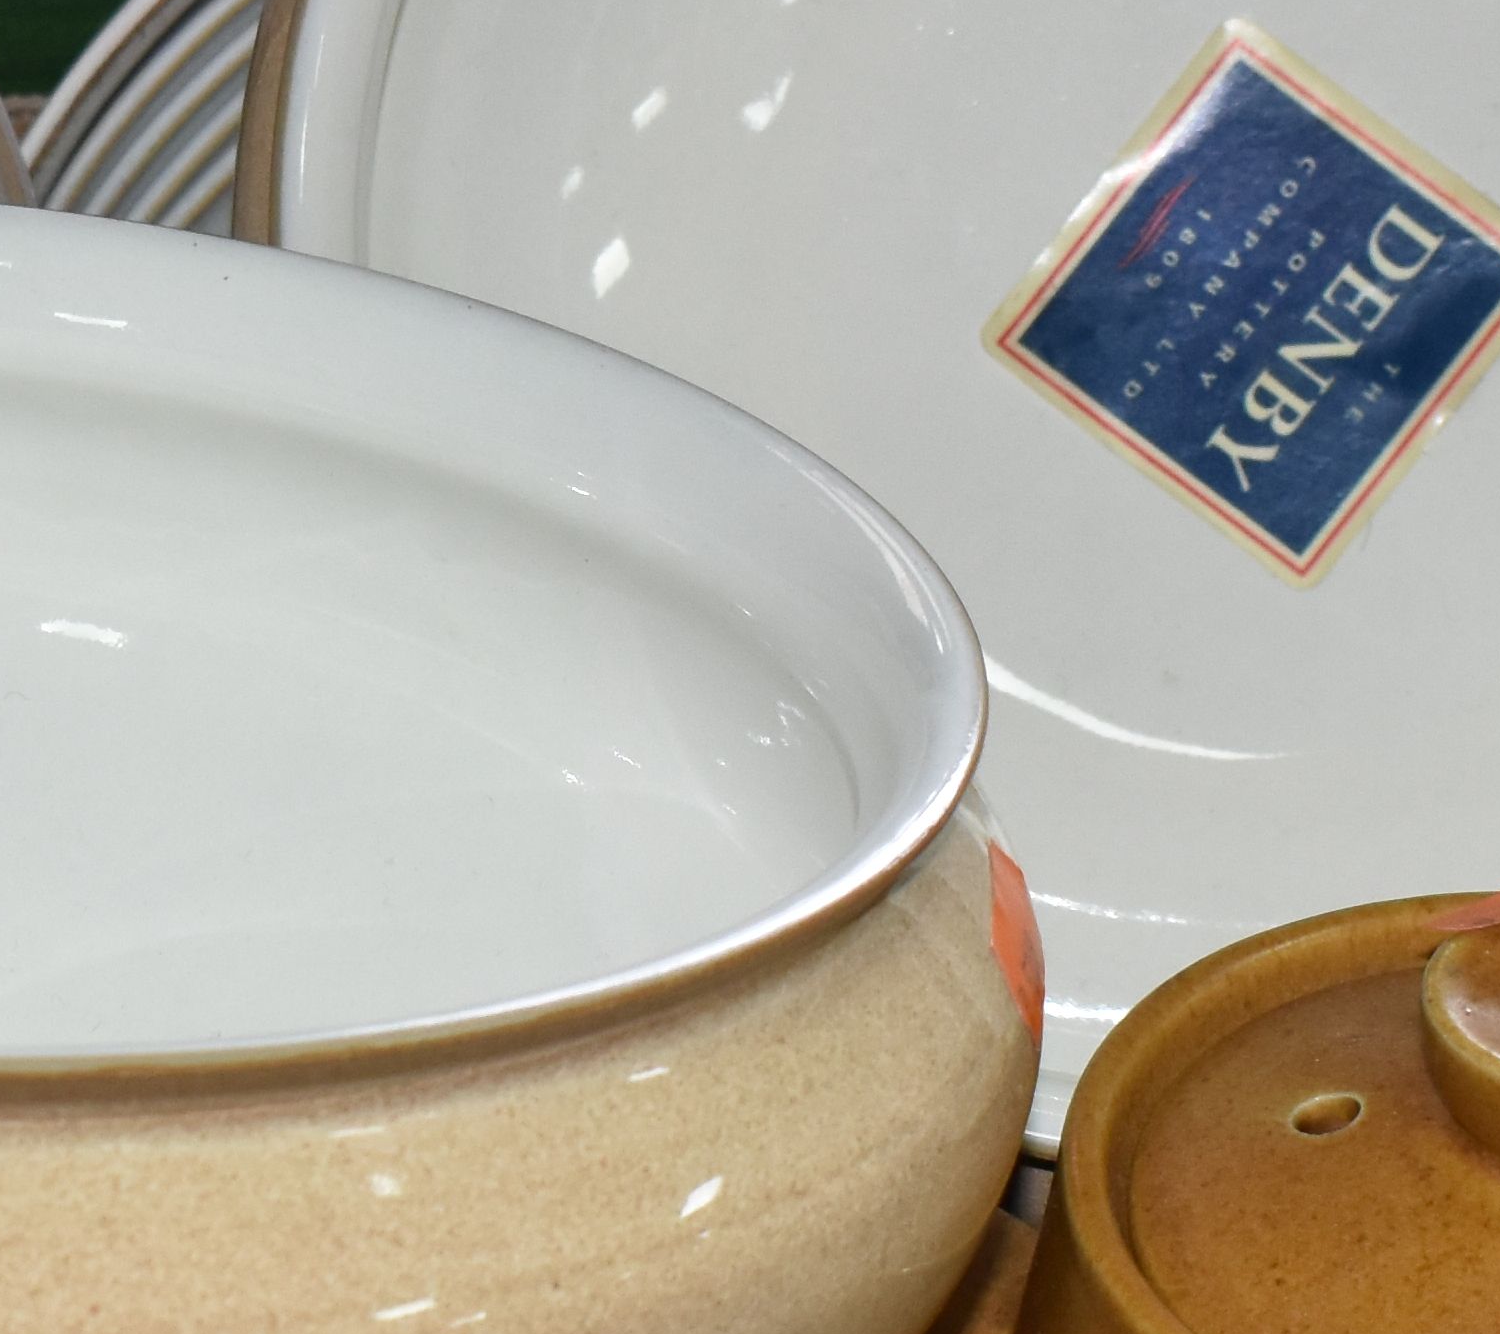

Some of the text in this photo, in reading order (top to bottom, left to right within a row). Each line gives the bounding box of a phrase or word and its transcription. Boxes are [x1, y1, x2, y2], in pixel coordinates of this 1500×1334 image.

[1123, 154, 1317, 399] COMPANY LTD
[1144, 208, 1213, 290] 1809
[1199, 228, 1326, 389] POTTERY
[1206, 203, 1445, 493] DENBY
[1345, 364, 1401, 424] THE
